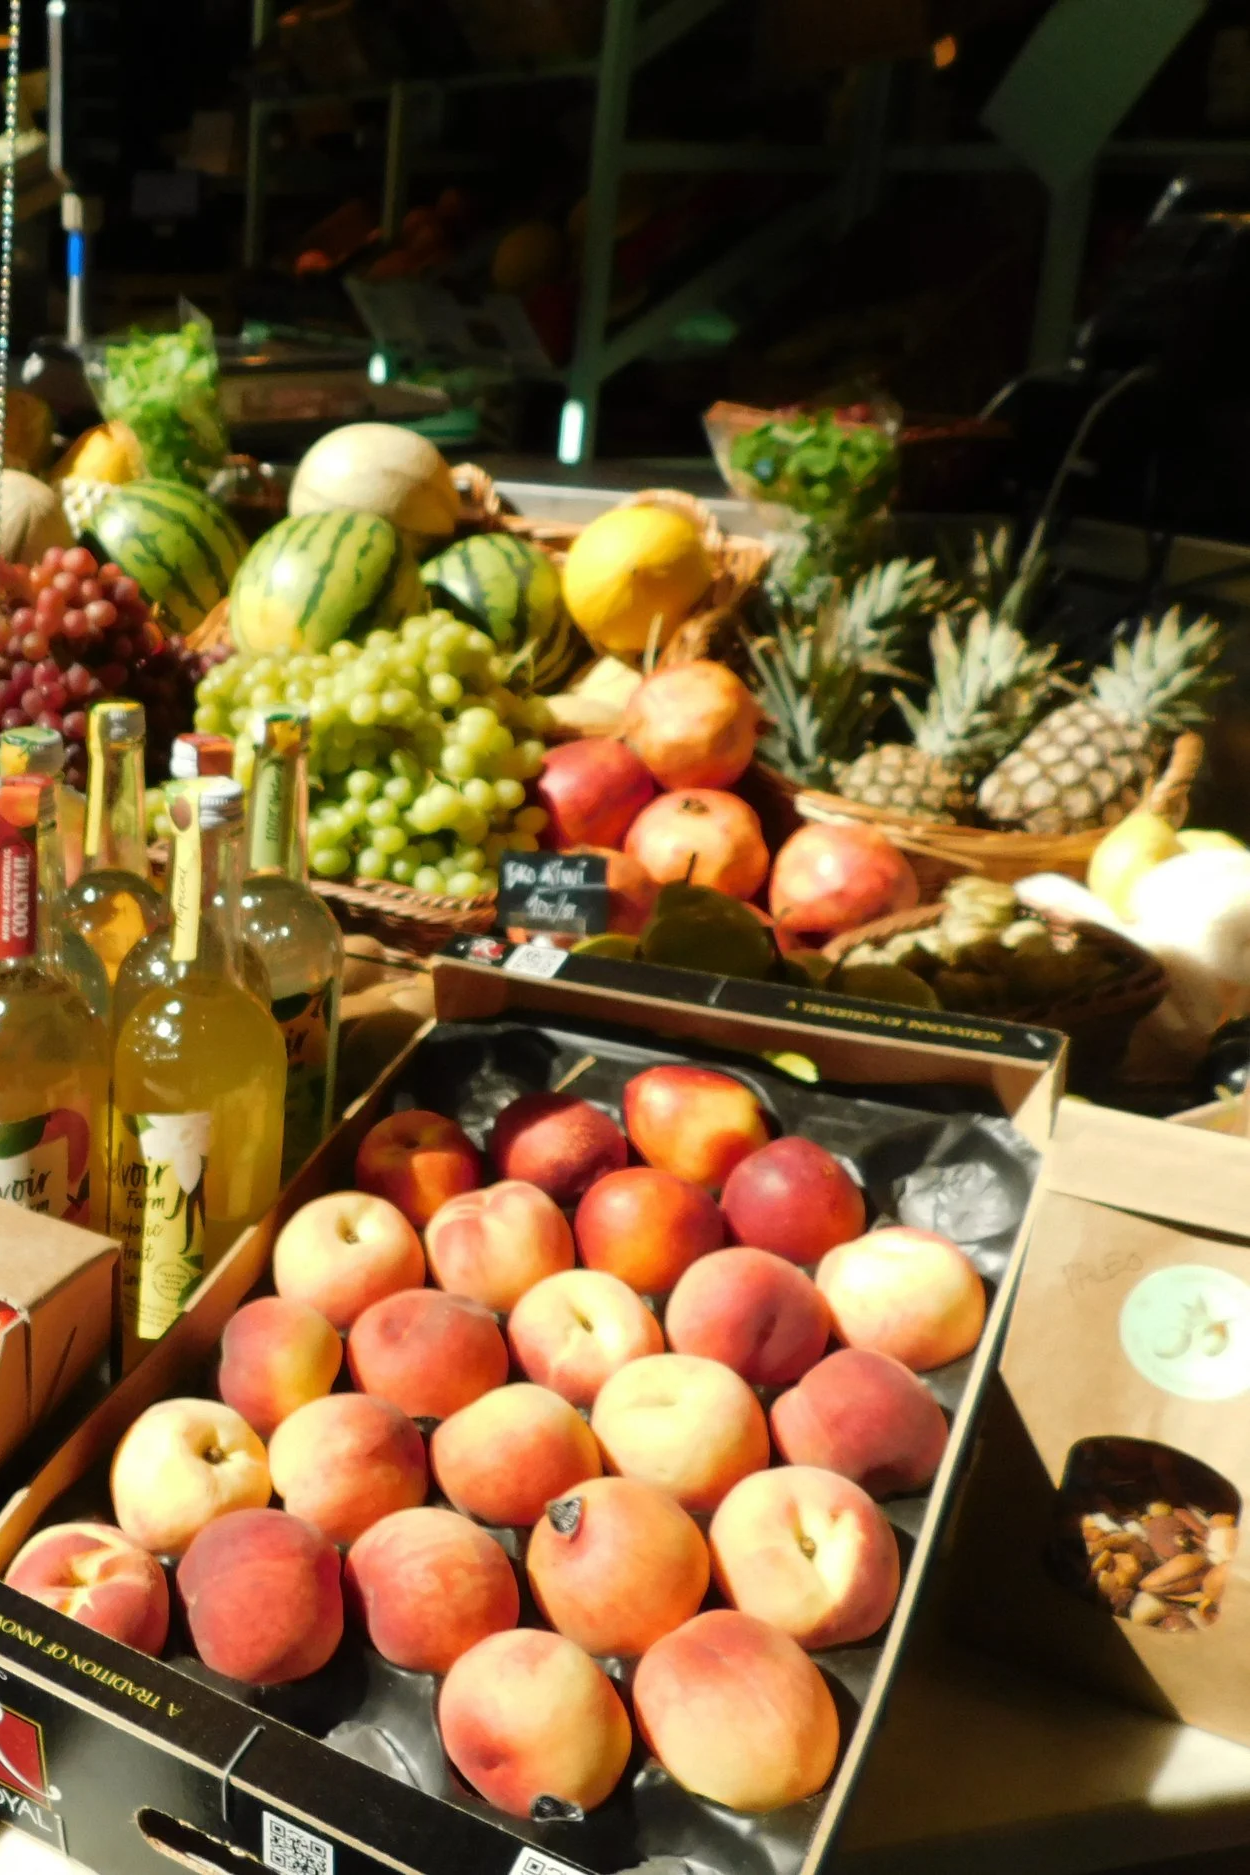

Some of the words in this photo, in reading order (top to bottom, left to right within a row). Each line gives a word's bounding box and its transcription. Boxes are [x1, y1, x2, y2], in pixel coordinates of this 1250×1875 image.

[12, 854, 31, 938] COCKTAIL
[41, 1641, 68, 1660] OF
[68, 1654, 162, 1710] TRADITION
[166, 1702, 184, 1718] A
